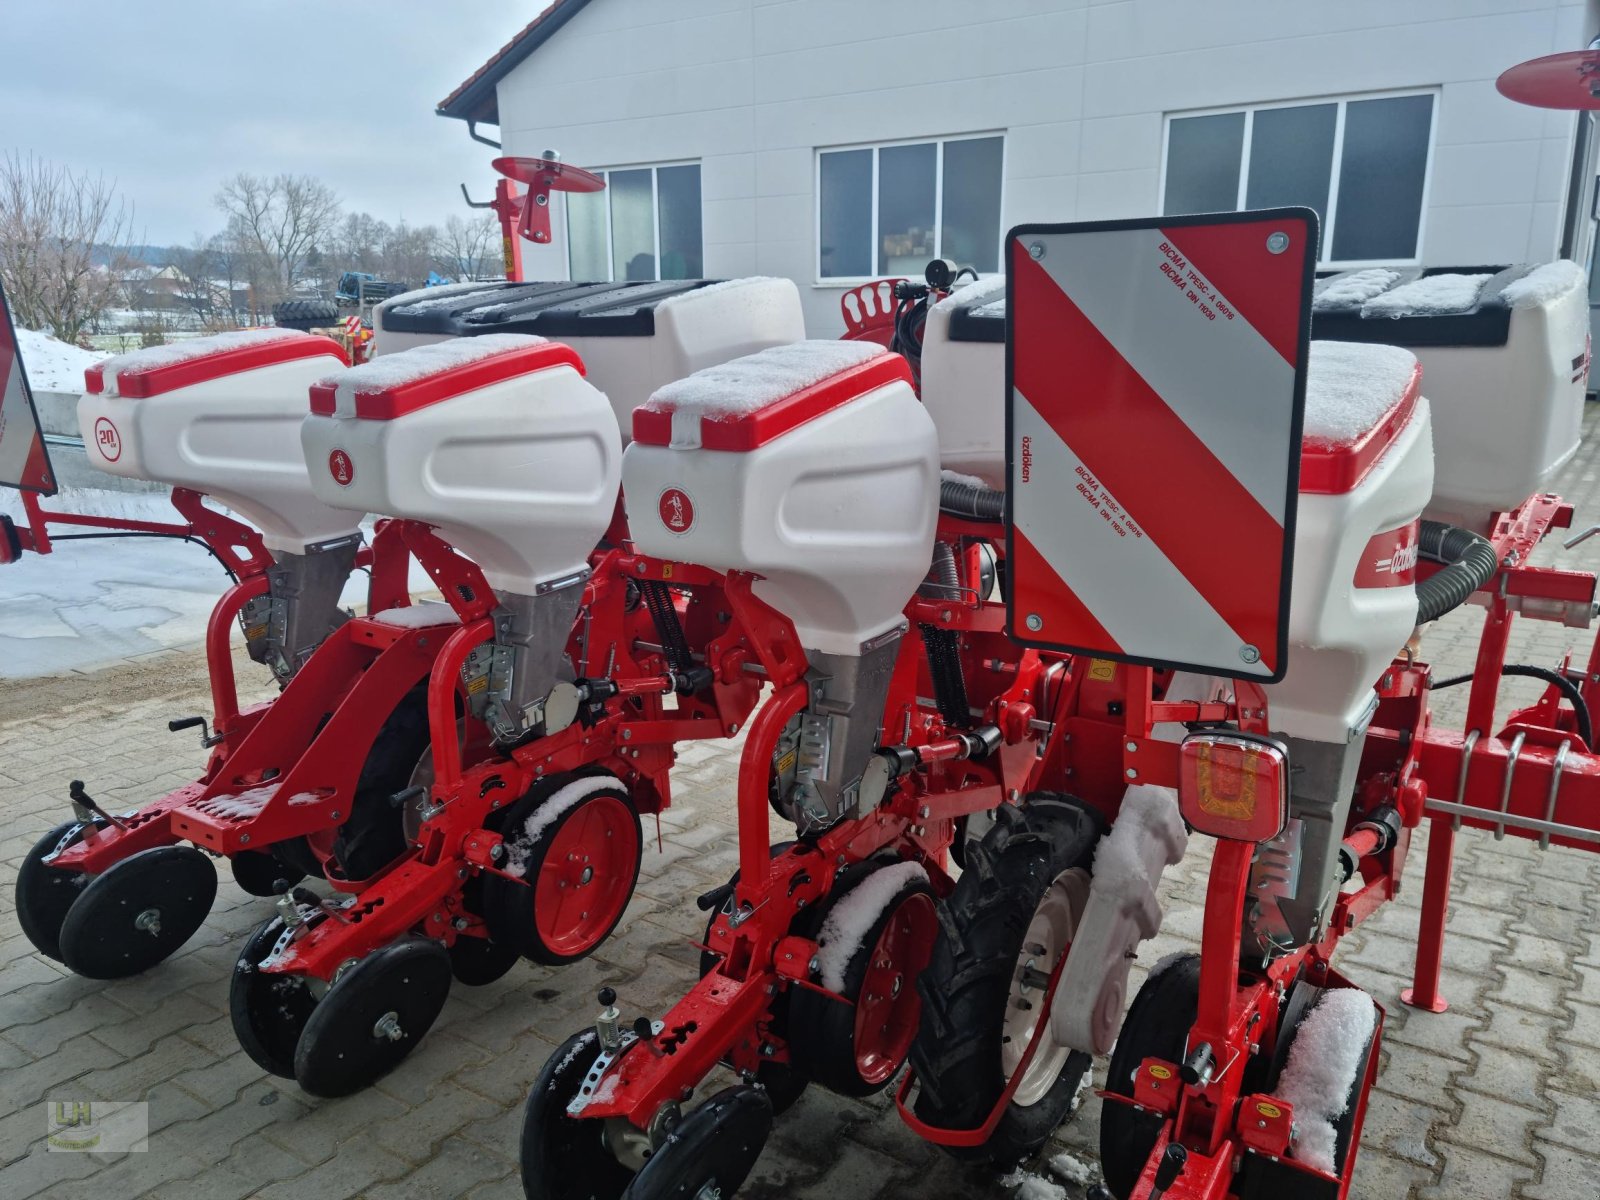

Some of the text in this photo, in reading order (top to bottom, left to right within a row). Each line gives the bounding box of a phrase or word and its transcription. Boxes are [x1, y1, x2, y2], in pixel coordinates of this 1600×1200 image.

[1158, 242, 1186, 270] BICMA
[1215, 300, 1235, 320] 06016
[1159, 262, 1216, 321] BICMA DIN 11030
[99, 429, 114, 445] 20
[1022, 436, 1032, 483] özdöken
[1074, 466, 1099, 491] BICMA
[1125, 520, 1143, 538] 06016
[1076, 483, 1127, 537] BICMA DIN 11030
